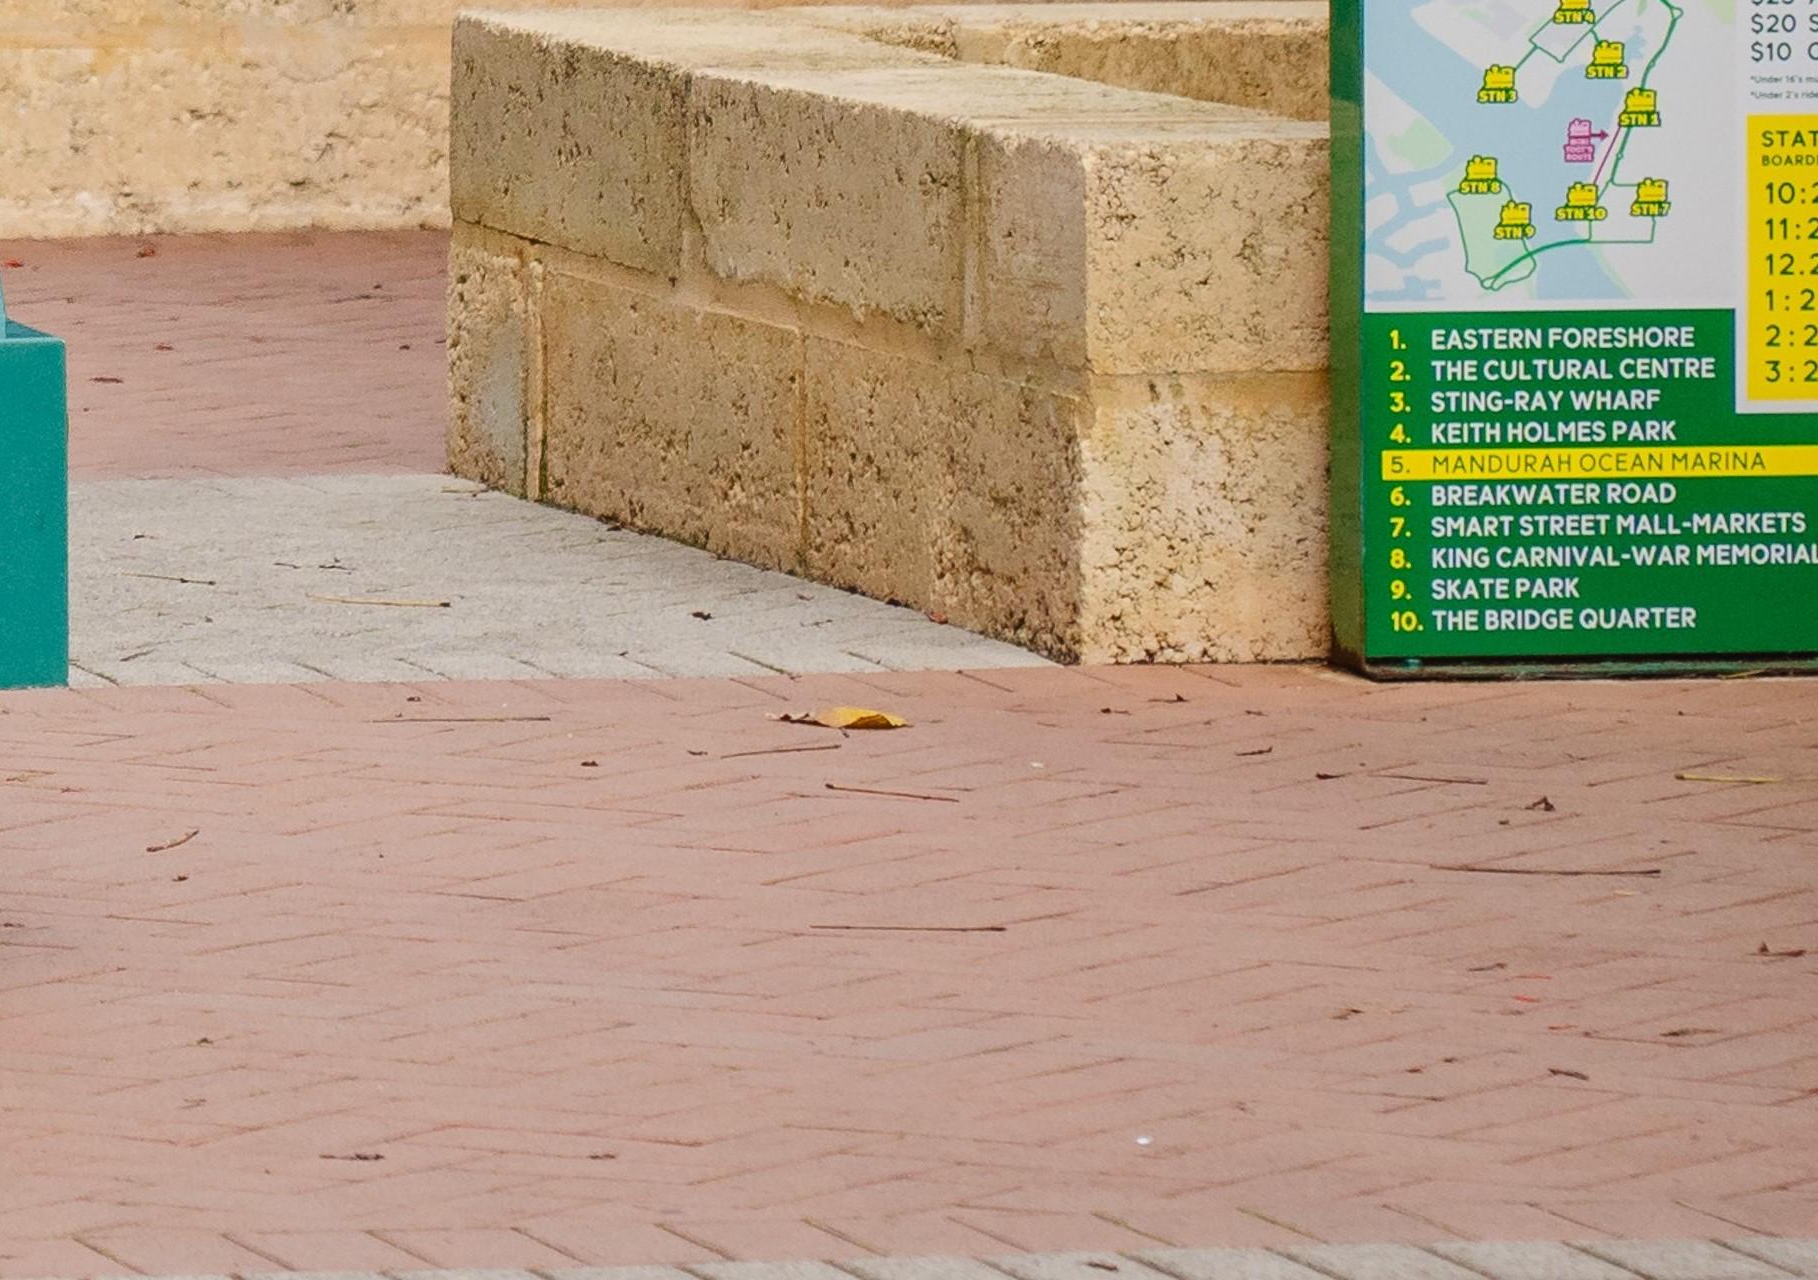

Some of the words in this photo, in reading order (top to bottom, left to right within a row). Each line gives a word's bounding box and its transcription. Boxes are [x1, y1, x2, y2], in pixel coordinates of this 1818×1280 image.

[1751, 13, 1796, 34] $20
[1751, 41, 1791, 62] $10
[1762, 155, 1818, 166] BOARD
[1390, 330, 1406, 349] 1.
[1432, 329, 1541, 350] EASTERN
[1549, 327, 1694, 348] FORESHORE
[1391, 361, 1410, 381] 2.
[1432, 360, 1477, 380] THE
[1484, 359, 1613, 380] CULTURAL
[1620, 358, 1715, 379] CENTRE
[1390, 392, 1410, 412] 3.
[1432, 391, 1563, 412] STING-RAY
[1570, 389, 1660, 410] WHARF
[1390, 424, 1411, 443] 4.
[1432, 423, 1500, 443] KEITH
[1508, 421, 1606, 442] HOLMES
[1613, 421, 1676, 441] PARK
[1392, 456, 1409, 473] 5.
[1433, 455, 1571, 473] MANDURAH
[1580, 453, 1662, 472] OCEAN
[1672, 452, 1765, 470] MARINA
[1391, 487, 1410, 506] 6.
[1432, 484, 1600, 506] BREAKWATER
[1607, 483, 1676, 503] ROAD
[1391, 517, 1410, 537] 7.
[1432, 516, 1514, 537] SMART
[1520, 515, 1610, 536] STREET
[1617, 512, 1806, 534] MALL-MARKETS
[1391, 549, 1411, 569] 8.
[1432, 547, 1490, 568] KING
[1496, 545, 1690, 568] CARNIVAL-WAR
[1391, 580, 1411, 599] 9.
[1432, 579, 1509, 600] SKATE
[1516, 578, 1579, 598] PARK
[1392, 611, 1423, 631] 10.
[1432, 610, 1478, 630] THE
[1485, 609, 1573, 630] BRIDGE
[1579, 607, 1696, 629] QUARTER
